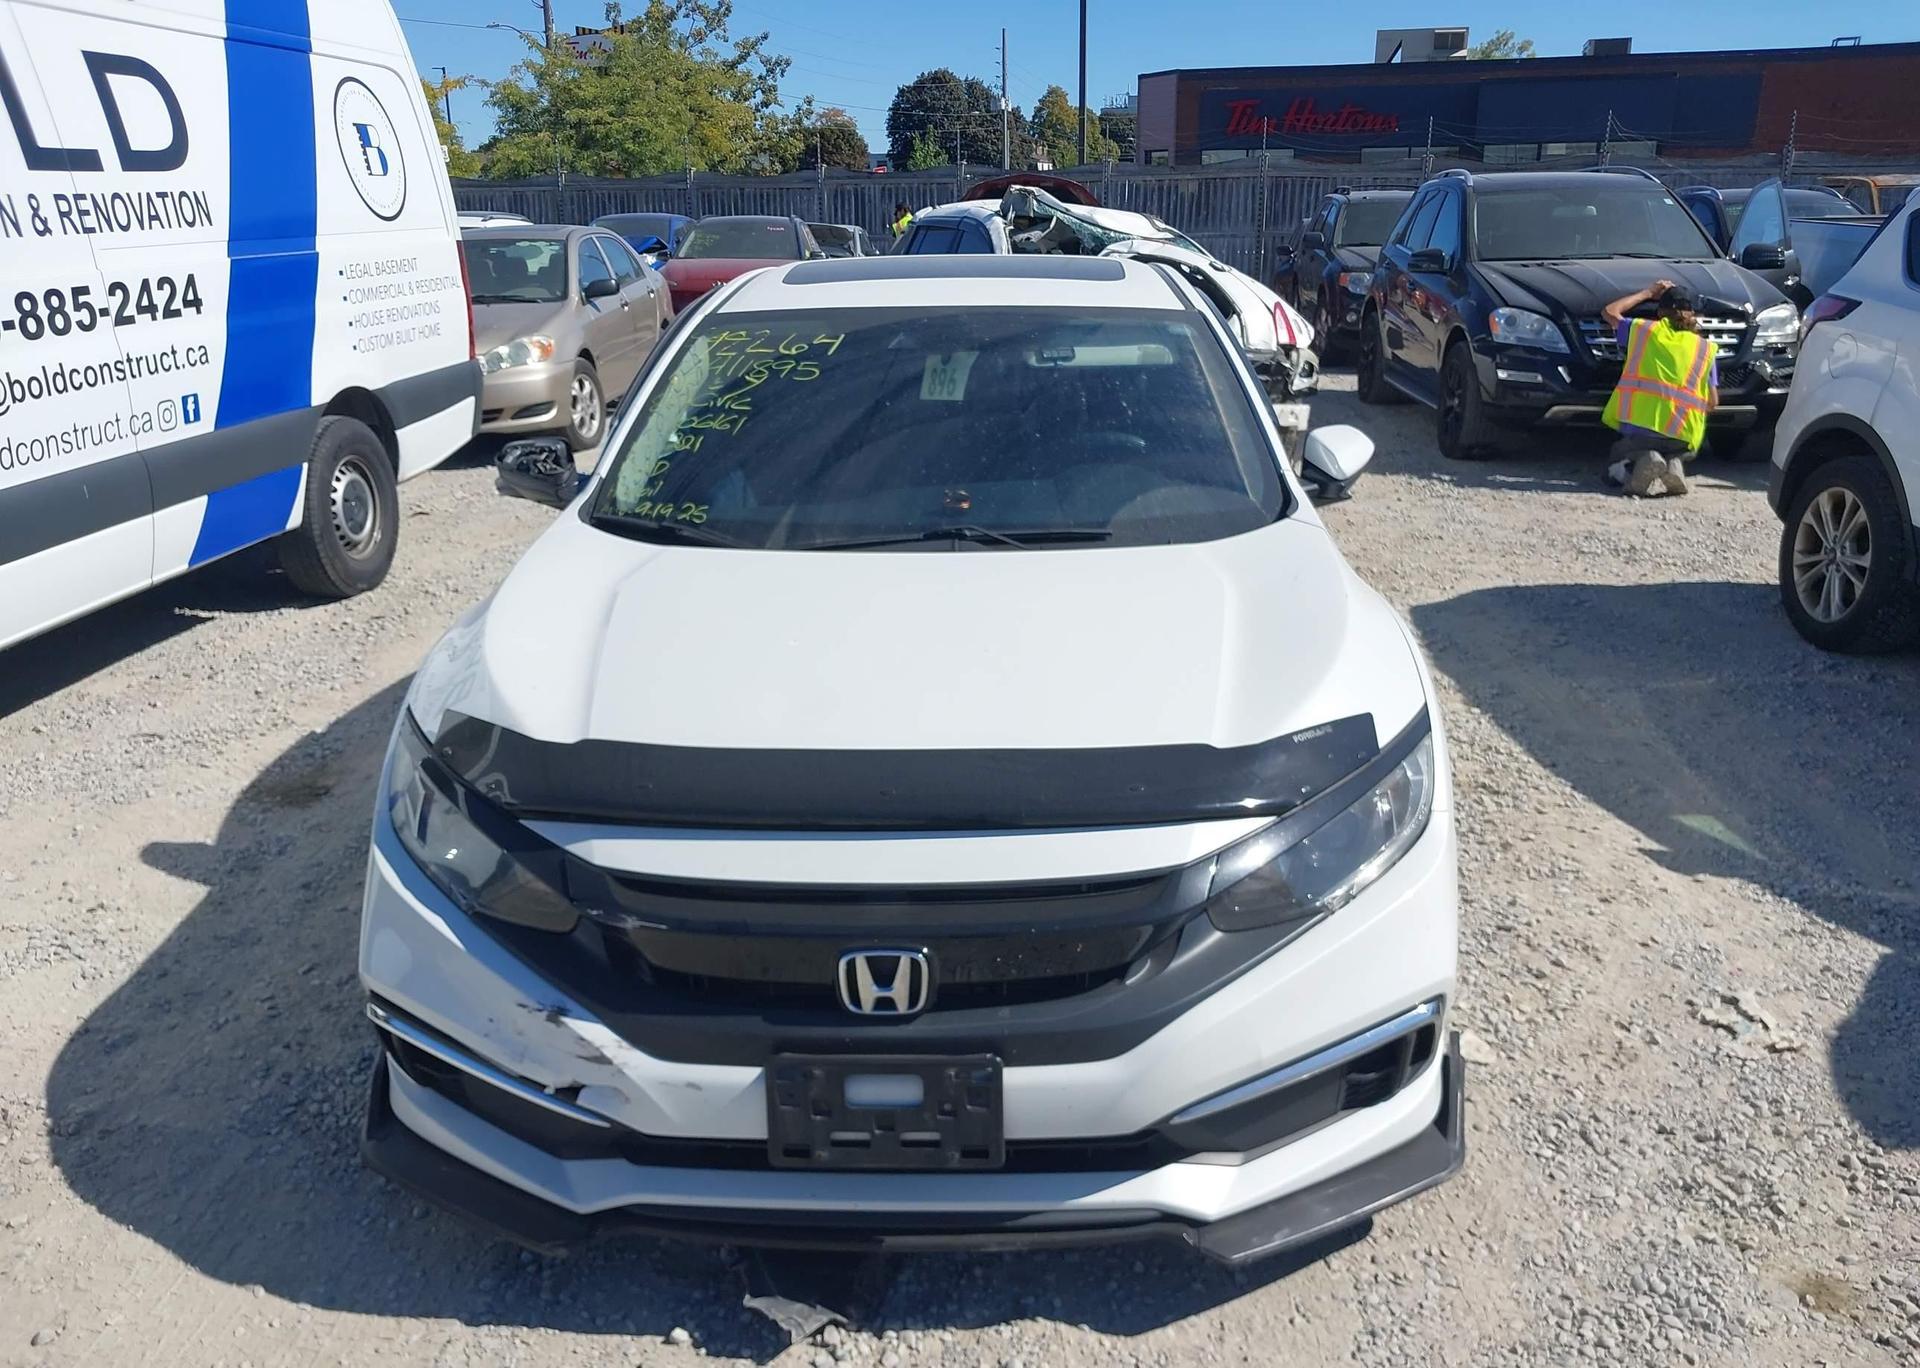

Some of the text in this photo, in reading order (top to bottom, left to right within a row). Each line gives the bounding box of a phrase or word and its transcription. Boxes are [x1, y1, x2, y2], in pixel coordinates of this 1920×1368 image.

[1225, 97, 1397, 135] Tim Hortons
[27, 193, 53, 237] &
[53, 190, 213, 235] RENOVATION
[344, 257, 418, 280] LEGAL BASEMENT
[0, 273, 203, 341] -885-2424
[348, 283, 407, 305] COMMERCIAL
[416, 275, 461, 294] RESIDENTIAL
[354, 300, 440, 329] HOUSE RENOVATIONS
[358, 321, 441, 354] CUSTOM BUILT HOME
[0, 344, 210, 416] boldconstruct.ca
